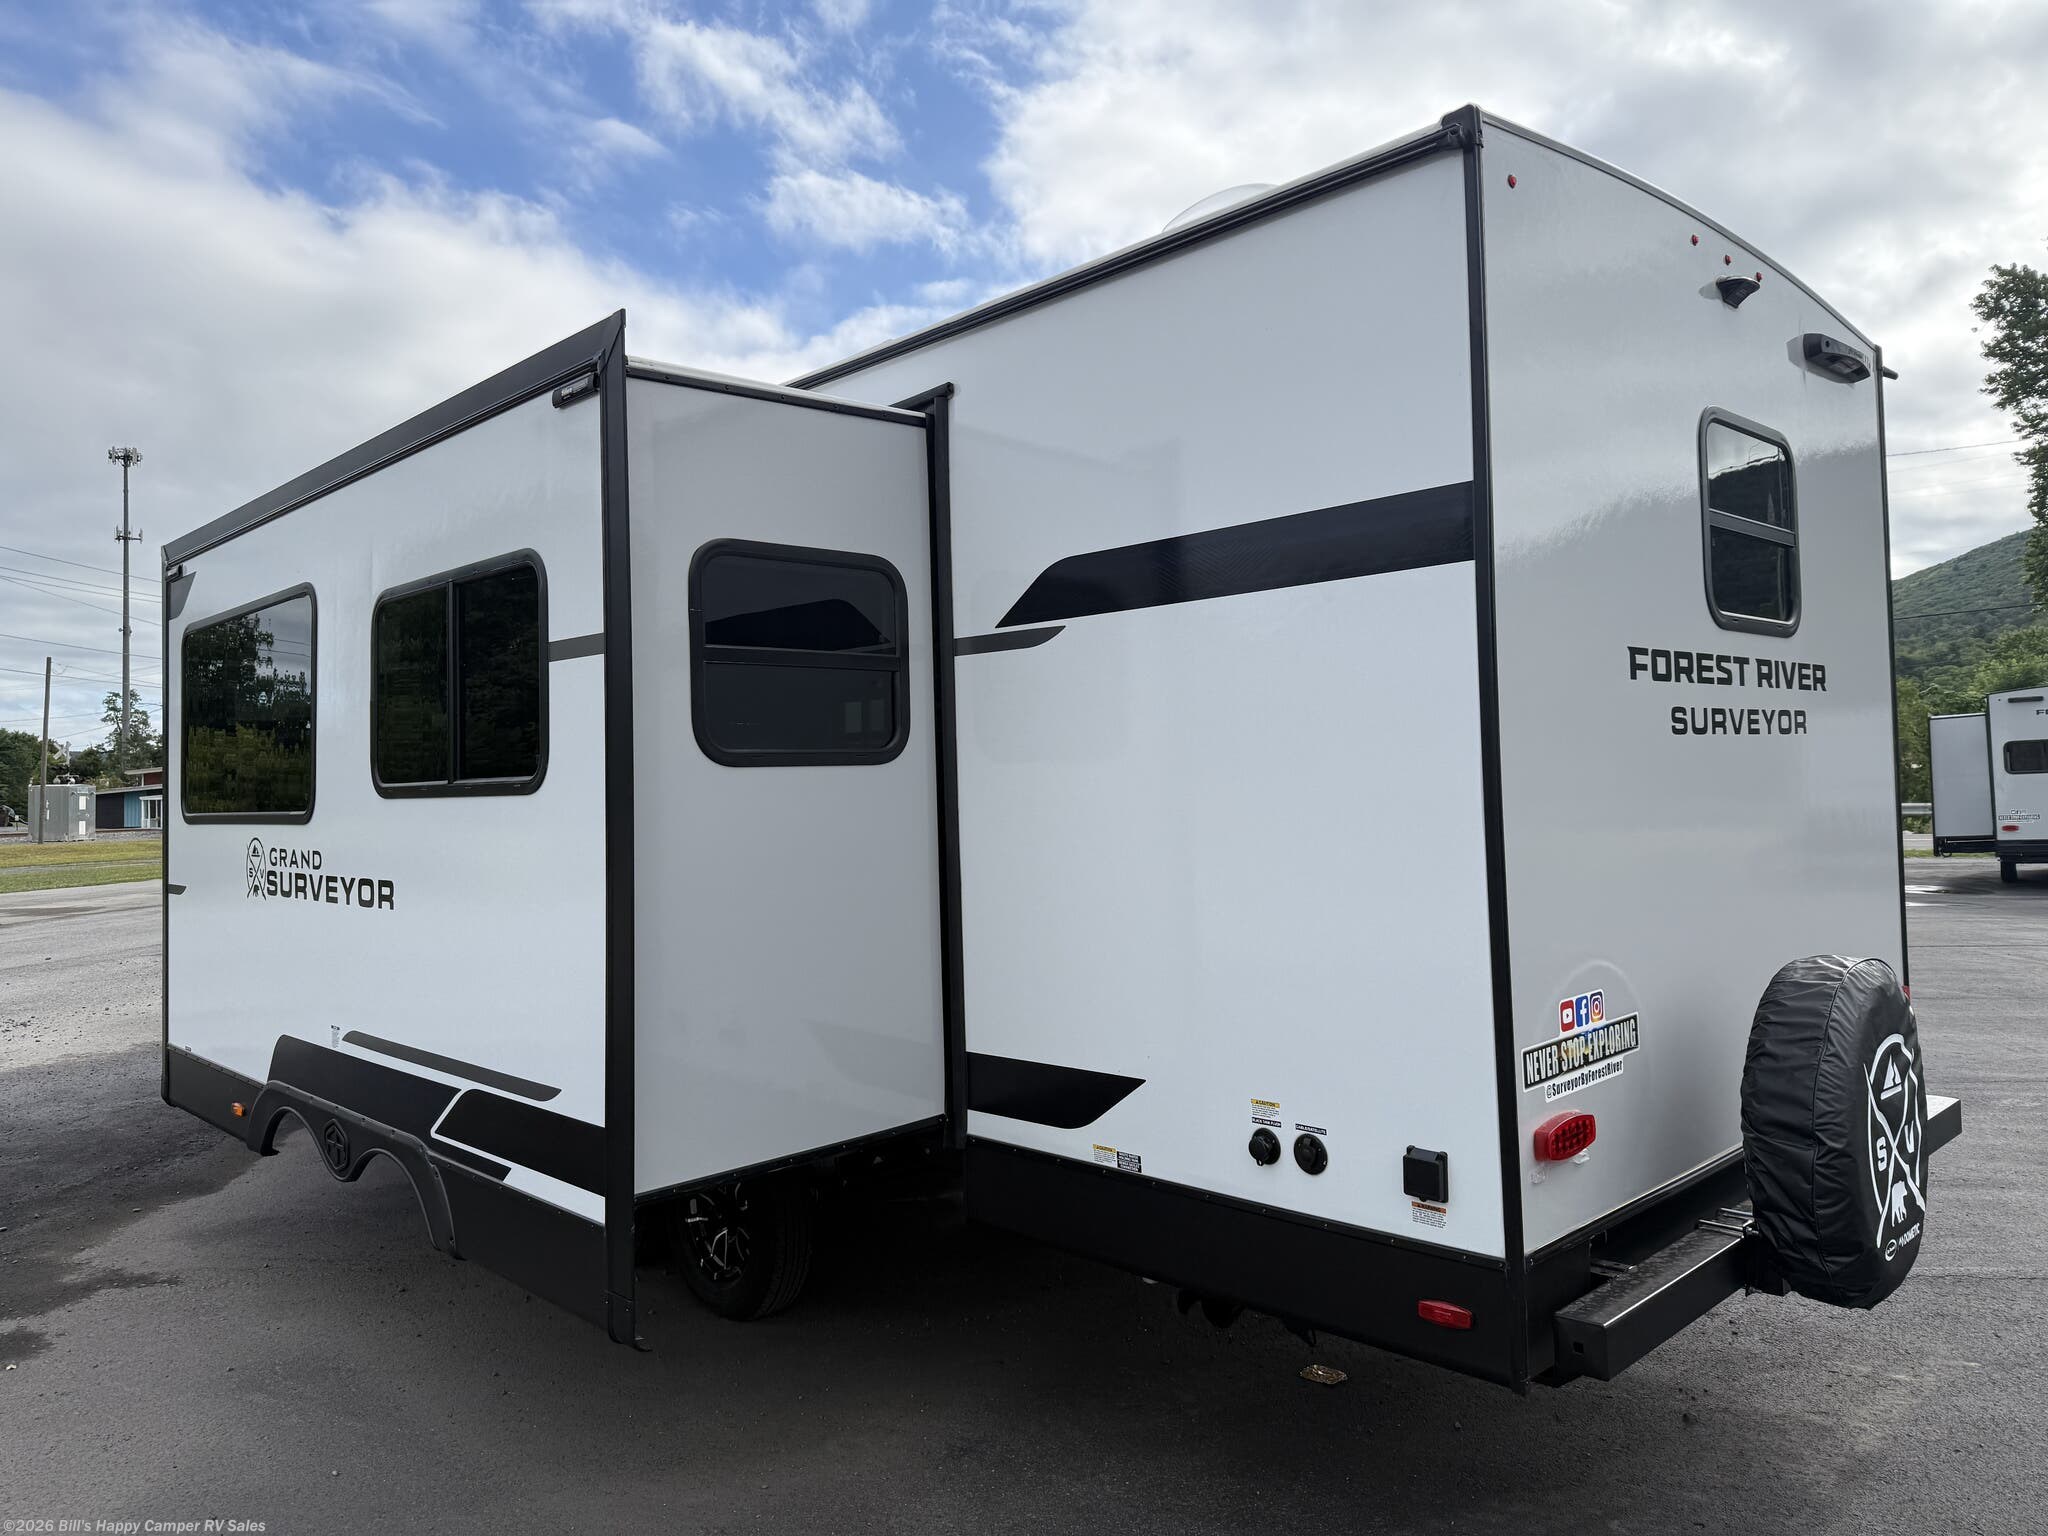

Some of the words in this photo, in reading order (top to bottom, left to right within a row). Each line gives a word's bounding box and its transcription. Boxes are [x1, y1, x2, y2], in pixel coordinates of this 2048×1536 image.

[1627, 646, 1750, 686] FOREST
[1755, 658, 1827, 691] RIVER
[1671, 706, 1807, 735] SURVEYOR
[269, 847, 322, 870] GRAND
[266, 870, 395, 910] SURVEYOR
[1526, 1045, 1560, 1085] NEVER
[1561, 1034, 1586, 1072] STOP
[1588, 1019, 1637, 1060] EXPLORING
[1546, 1060, 1622, 1098] @SurveyorByForestRiver
[1876, 1136, 1887, 1172] S
[1904, 1120, 1915, 1154] V
